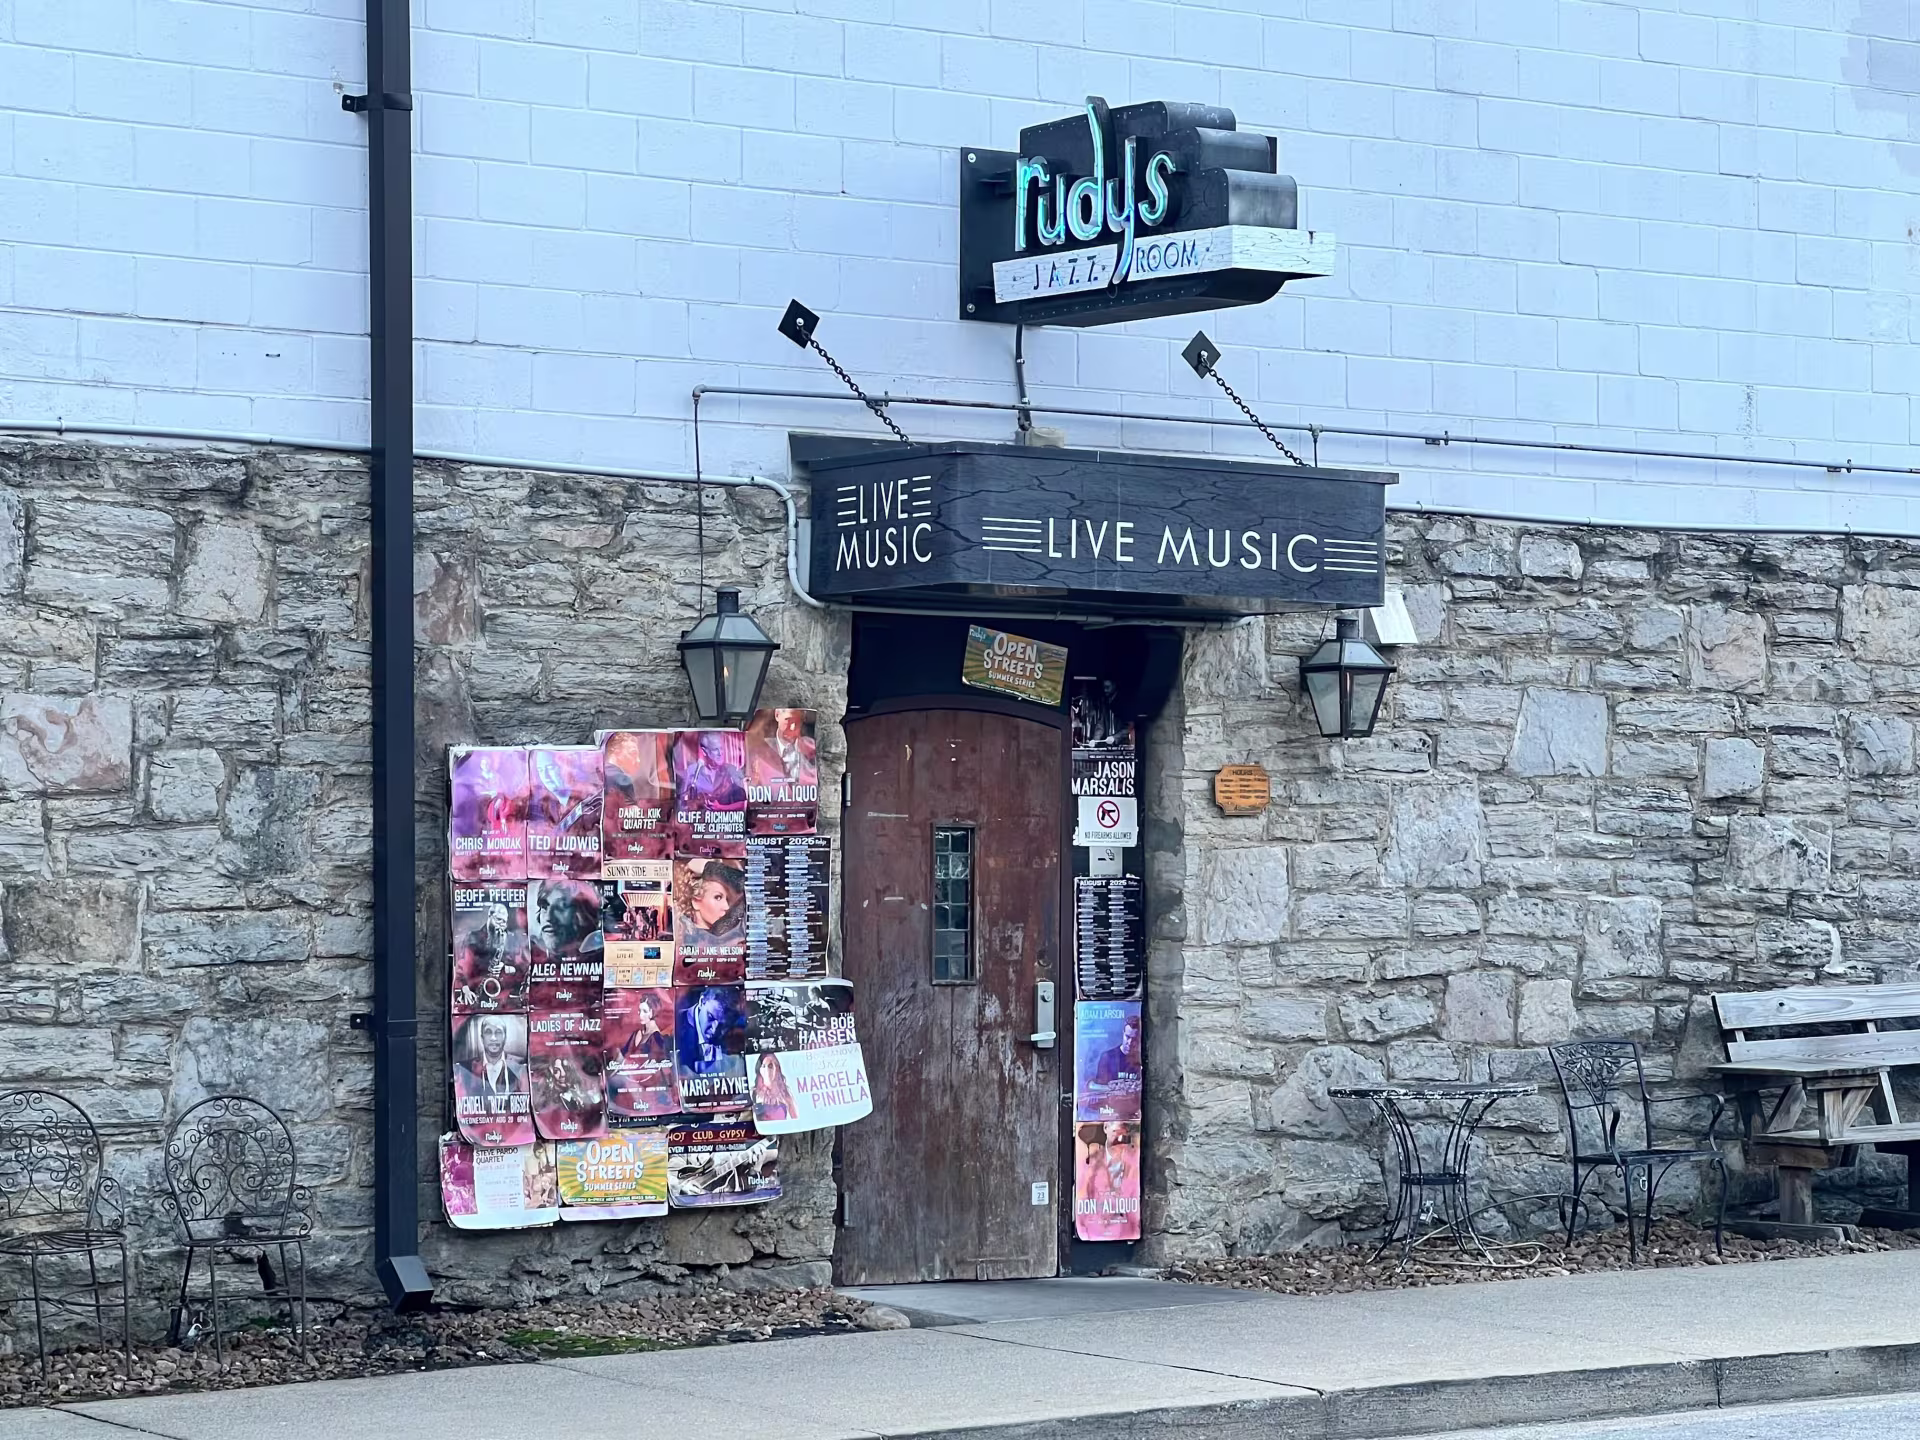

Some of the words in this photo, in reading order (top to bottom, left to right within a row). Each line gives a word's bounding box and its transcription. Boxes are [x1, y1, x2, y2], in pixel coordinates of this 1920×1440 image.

[1033, 255, 1098, 290] JAZZ
[1136, 239, 1198, 274] ROOM
[860, 479, 908, 524] LIVE
[836, 523, 932, 571] MUSIC
[1048, 518, 1134, 562] LIVE
[1157, 525, 1318, 573] MUSIC
[984, 649, 1043, 679] STREETS
[1093, 761, 1135, 779] JASON
[748, 786, 771, 802] DON
[777, 785, 817, 802] ALIQUO
[1071, 777, 1135, 796] MARSALIS
[618, 808, 645, 818] DANIEL
[647, 808, 661, 818] KUK
[677, 811, 702, 823] CLIFF
[704, 811, 745, 823] RICHMOND
[623, 819, 657, 829] QUARTET
[693, 823, 706, 832] THE
[708, 823, 744, 832] CLIFFNOTES
[1084, 831, 1091, 840] NO
[1091, 831, 1112, 840] FIREARMS
[1112, 831, 1131, 840] ALLOWED
[455, 837, 484, 850] CHRIS
[487, 836, 522, 850] MONDAK
[528, 836, 551, 850] TED
[555, 836, 599, 850] LUDWIG
[606, 866, 630, 877] SUNNY
[631, 866, 647, 877] SIDE
[454, 889, 485, 901] GEOFF
[489, 889, 526, 901] PFEIFER
[678, 946, 700, 956] SARAH
[701, 946, 718, 956] JANE
[719, 946, 744, 956] NELSON
[531, 963, 556, 976] ALEC
[559, 962, 603, 976] NEWNAM
[1081, 1009, 1099, 1019] ADAM
[1100, 1009, 1125, 1019] LARSON
[530, 1020, 561, 1032] LADIES
[564, 1020, 575, 1031] OF
[578, 1018, 602, 1031] JAZZ
[830, 1016, 855, 1030] BOB
[798, 1028, 857, 1044] HARSEN
[679, 1079, 710, 1097] MARC
[713, 1077, 749, 1095] PAYNE
[796, 1068, 865, 1094] MARCELA
[811, 1086, 869, 1110] PINILLA
[456, 1096, 487, 1115] WENDELL
[461, 1116, 494, 1125] WEDNESDAY
[495, 1116, 507, 1124] AUG
[692, 1131, 714, 1140] CLUB
[719, 1129, 746, 1139] GYPSY
[475, 1149, 496, 1157] STEVE
[496, 1147, 519, 1155] PARDO
[668, 1145, 685, 1154] EVERY
[687, 1144, 714, 1152] THURSDAY
[475, 1156, 505, 1165] QUARTET
[575, 1160, 645, 1183] STREETS
[583, 1182, 614, 1192] SUMMER
[614, 1181, 637, 1191] SERIES
[1077, 1199, 1097, 1215] DON
[1102, 1197, 1138, 1215] ALIQUO
